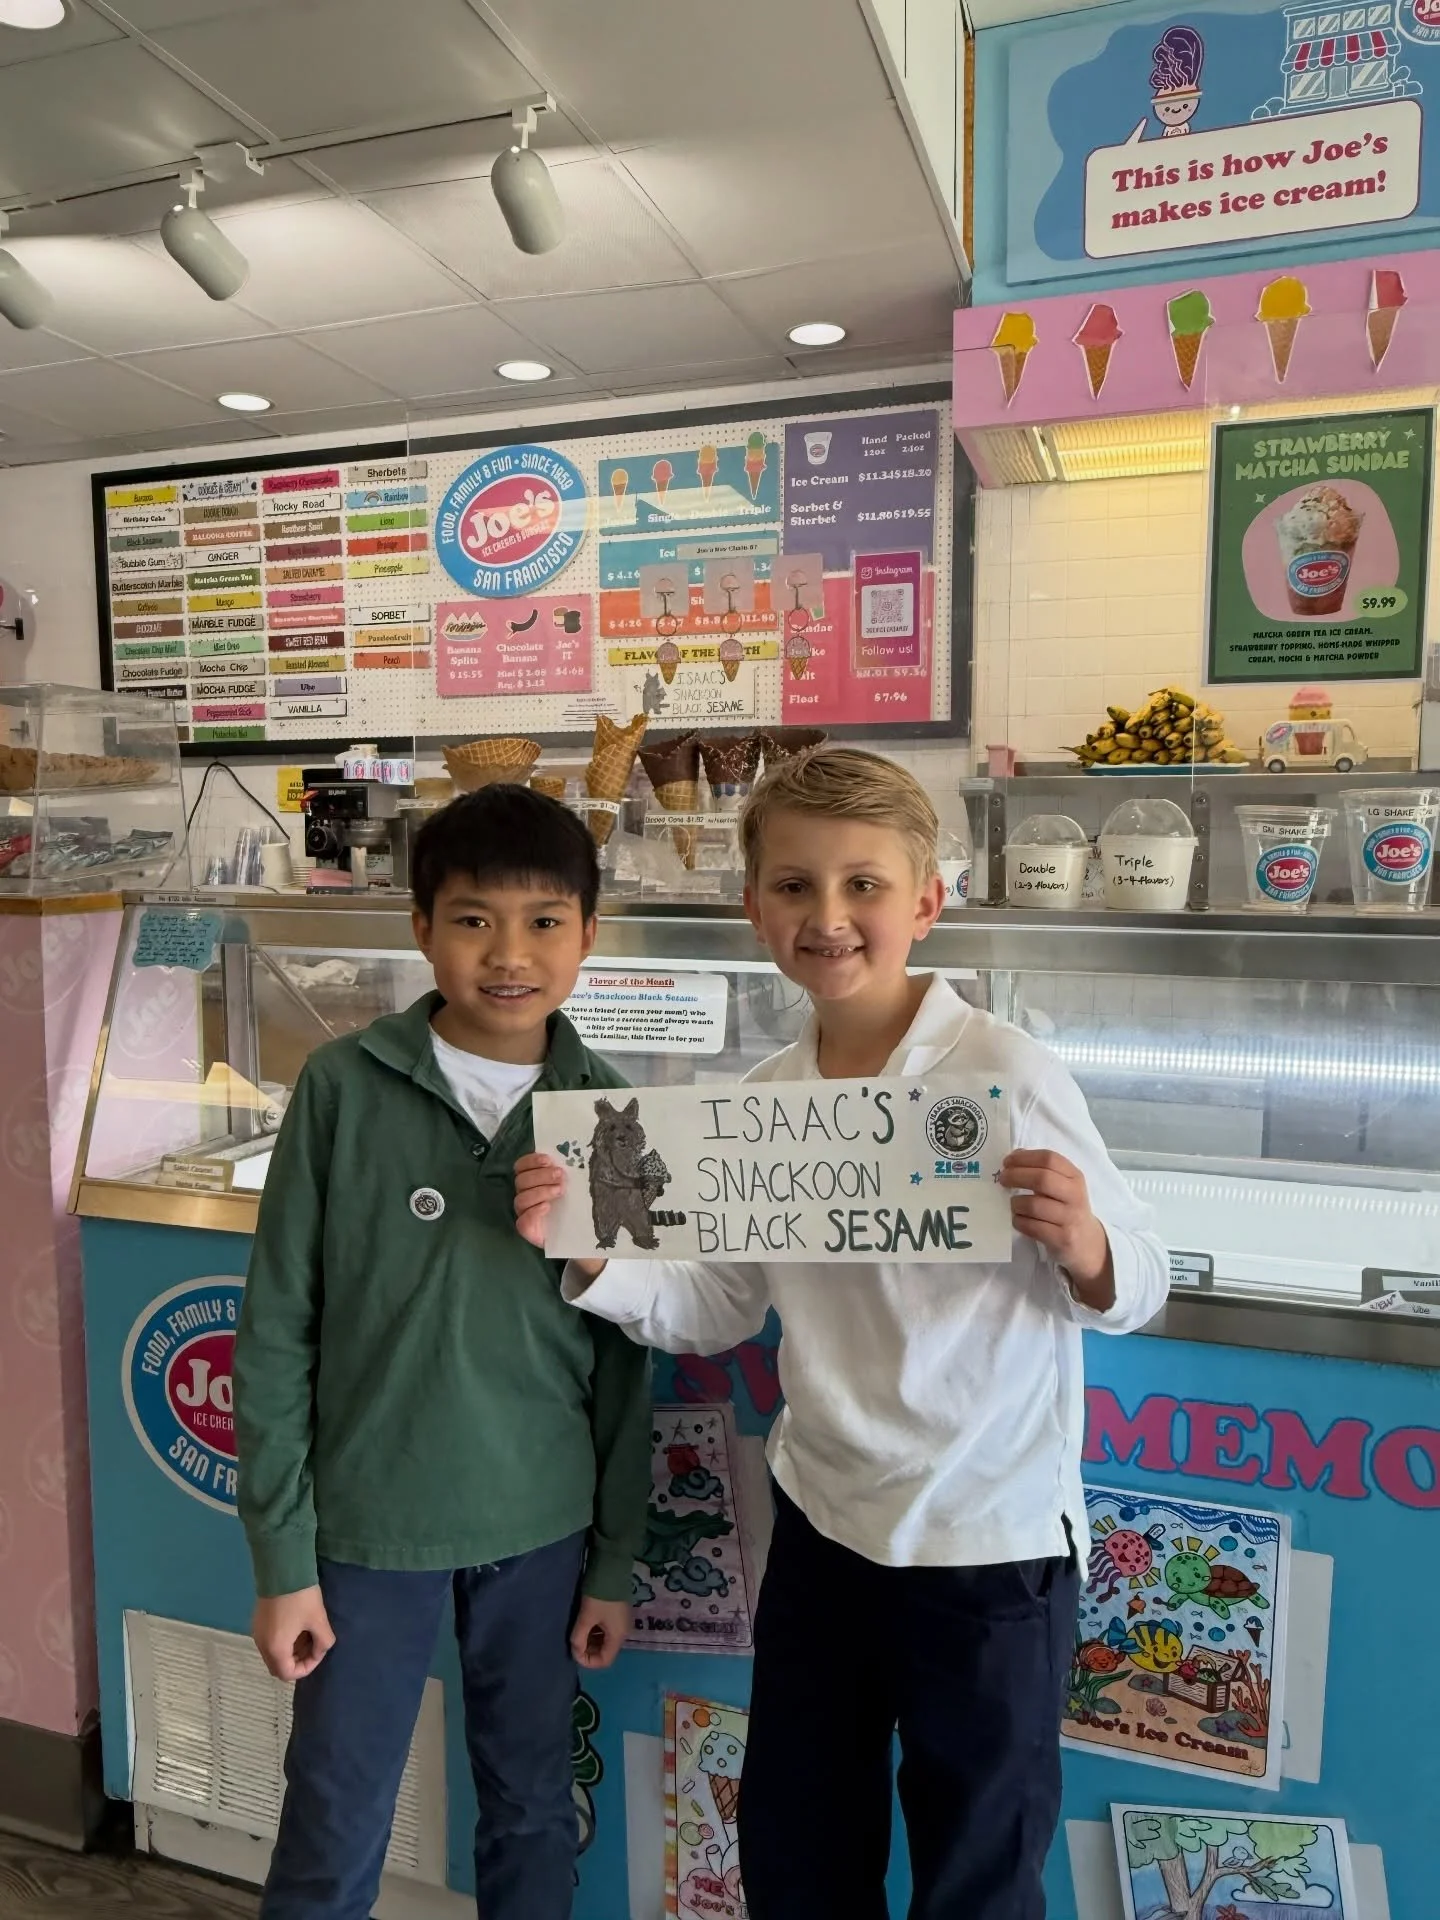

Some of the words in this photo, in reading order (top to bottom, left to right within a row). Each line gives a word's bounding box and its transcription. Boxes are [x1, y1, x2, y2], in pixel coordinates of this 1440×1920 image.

[1112, 164, 1179, 192] This
[1188, 159, 1213, 182] is
[1222, 150, 1296, 176] how
[1303, 133, 1388, 164] Joe's
[1112, 200, 1212, 229] makes
[1220, 192, 1265, 214] ice
[1273, 170, 1387, 207] cream!
[862, 436, 887, 444] Hand
[896, 431, 931, 442] Packed
[1254, 431, 1391, 458] STRAWBERRY
[491, 456, 512, 474] FUN
[521, 453, 553, 473] SINCE
[1235, 460, 1323, 481] MATCHA
[1327, 451, 1409, 474] SUNDAE
[368, 467, 406, 477] Sherbets
[792, 477, 808, 487] Ice
[811, 476, 849, 485] Cream
[450, 470, 485, 509] FAMILY
[273, 501, 298, 511] Rocky
[302, 499, 324, 508] Road
[791, 502, 830, 513] Sorbet
[833, 501, 842, 510] &
[467, 489, 555, 548] Joe's
[790, 515, 836, 525] Sherbet
[442, 511, 459, 544] FOOD,
[208, 552, 239, 561] GINGER
[474, 568, 500, 590] SAN
[506, 532, 574, 589] FRANCISCO
[121, 560, 146, 568] Bubble
[148, 558, 165, 566] Gum
[875, 566, 912, 577] Instagram
[1298, 565, 1339, 580] Joe's
[113, 582, 156, 591] Butterscotch
[158, 579, 182, 587] Marble
[1363, 597, 1396, 609] $9.99
[372, 611, 406, 620] SORBET
[192, 620, 223, 629] MARBLE
[228, 618, 256, 626] FUDGE
[447, 646, 481, 654] Banana
[496, 643, 544, 652] Chocolate
[692, 649, 715, 657] THE
[861, 645, 894, 656] Follow
[899, 644, 913, 653] us!
[503, 654, 538, 663] Banana
[1347, 652, 1379, 660] POWDER
[123, 669, 158, 677] Chocolate
[161, 668, 182, 676] Fudge
[200, 664, 225, 672] Mocha
[230, 663, 248, 672] Chip
[676, 670, 726, 685] ISAAC'S
[197, 685, 225, 694] MOCHA
[228, 685, 255, 693] FUDGE
[789, 695, 819, 704] Float
[288, 705, 322, 713] VANILLA
[707, 700, 744, 713] SESAME
[1377, 844, 1421, 858] Joe's
[1114, 855, 1154, 868] Triple
[1020, 863, 1056, 874] Double
[1268, 865, 1309, 878] Joe's
[589, 977, 617, 985] Flavor
[700, 1087, 894, 1144] ISAAC'S
[930, 1100, 950, 1125] ISAAC'S
[697, 1157, 881, 1203] SNACKOON
[688, 1210, 807, 1253] BLACK
[825, 1206, 973, 1252] SESAME
[142, 1328, 176, 1376] FOOD,
[166, 1299, 222, 1336] FAMILY
[226, 1299, 236, 1321] &
[193, 1412, 208, 1426] ICE
[169, 1436, 209, 1480] SAN
[1075, 1711, 1130, 1734] Joe's
[1136, 1723, 1168, 1743] Ice
[1175, 1732, 1249, 1760] Cream
